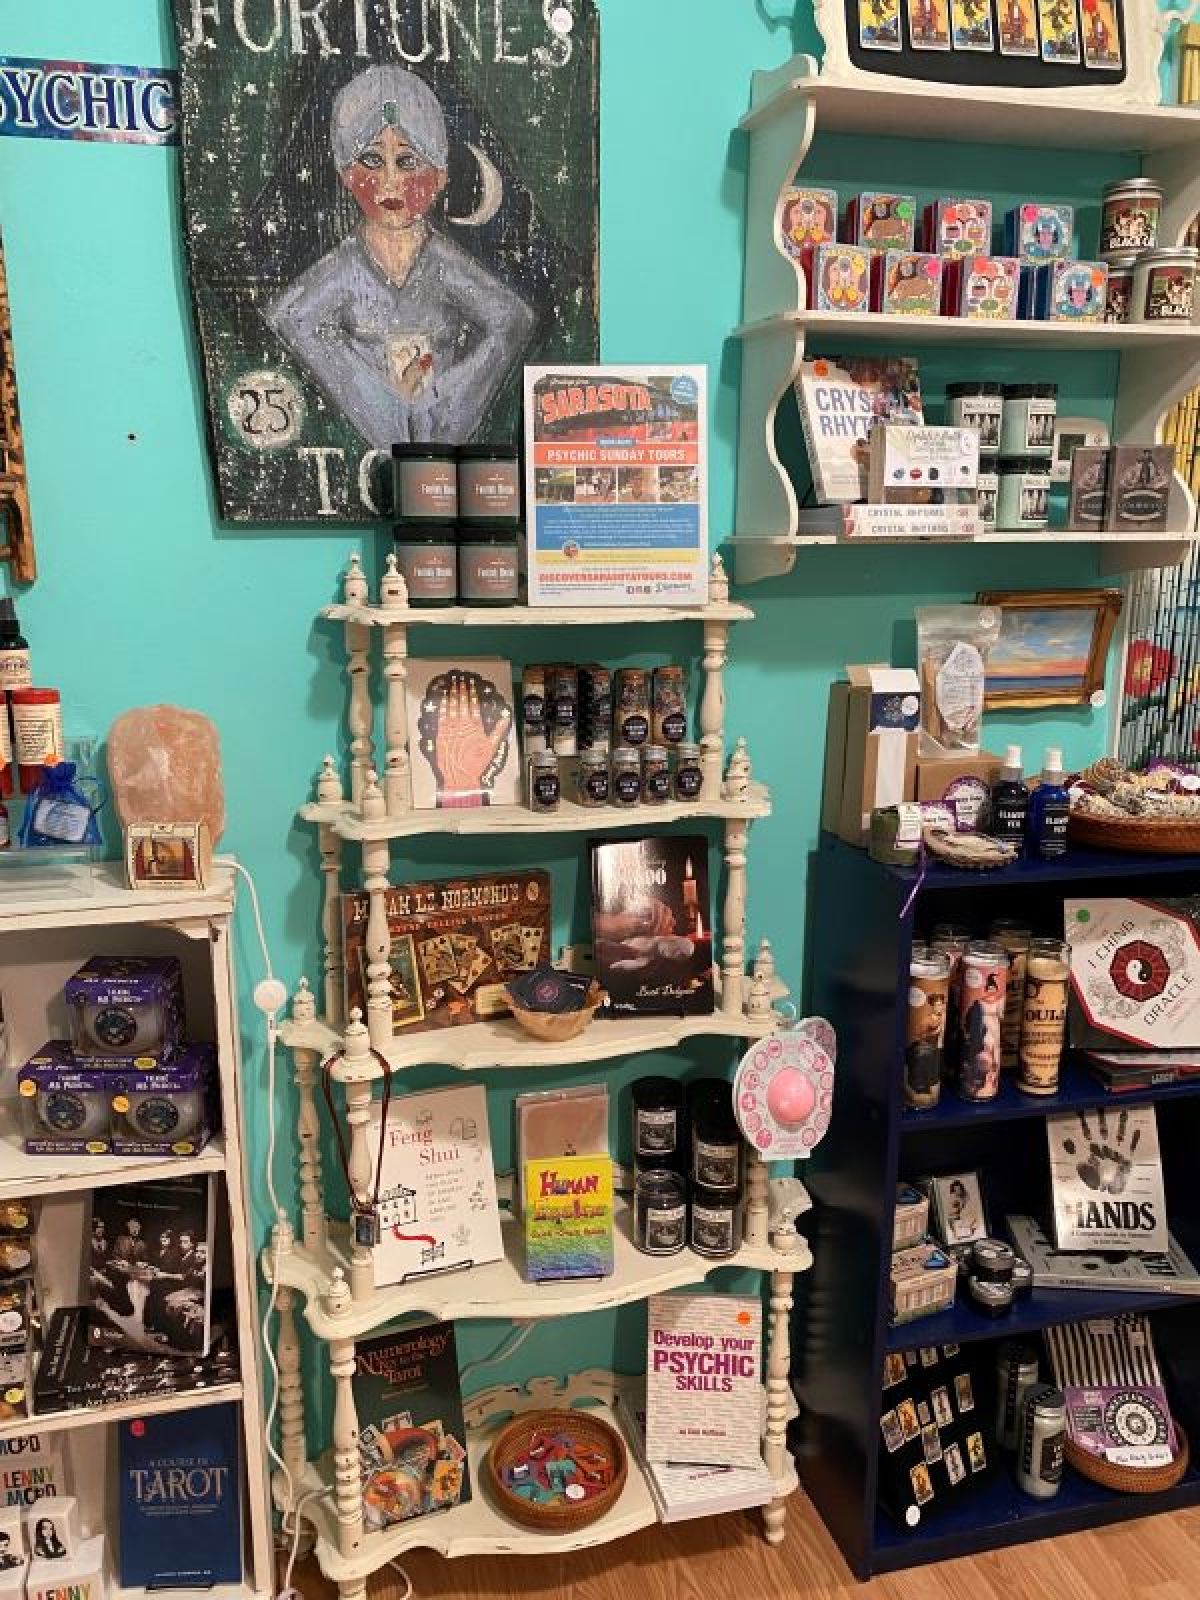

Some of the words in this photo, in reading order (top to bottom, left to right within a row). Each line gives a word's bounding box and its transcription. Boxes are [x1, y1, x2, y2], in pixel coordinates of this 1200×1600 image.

[182, 0, 573, 68] FORTUNES
[0, 68, 174, 132] YCHIC
[547, 449, 597, 461] PSYCHIC
[599, 449, 645, 461] SUNDAY
[649, 449, 686, 461] TOURS
[1095, 919, 1137, 961] CHING
[1142, 970, 1195, 1027] ORACLE
[388, 1127, 433, 1148] Feng
[419, 1143, 460, 1167] Shui
[653, 1329, 714, 1350] Develop
[721, 1336, 755, 1352] your
[354, 1332, 450, 1377] Numerology
[653, 1350, 755, 1377] PSYCHIC
[675, 1375, 733, 1393] SKILLS
[3, 1467, 54, 1490] LENNY
[129, 1467, 229, 1503] TAROT
